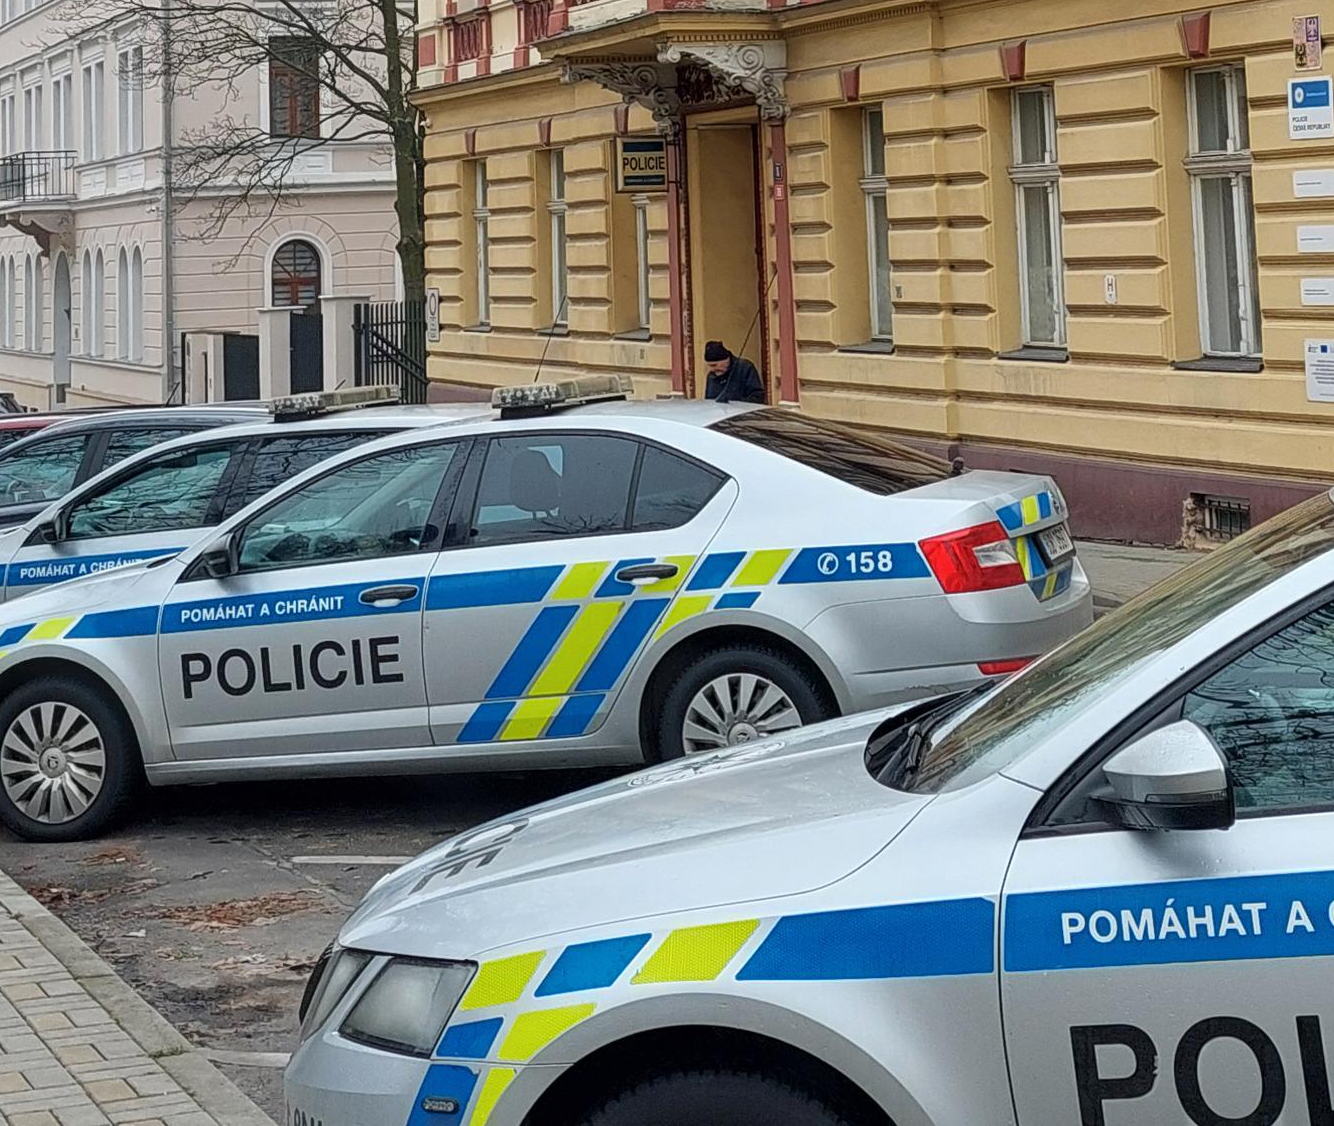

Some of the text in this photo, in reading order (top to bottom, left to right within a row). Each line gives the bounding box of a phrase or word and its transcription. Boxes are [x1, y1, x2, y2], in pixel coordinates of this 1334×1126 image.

[623, 156, 666, 171] POLICIE
[20, 563, 75, 579] POMÁHAT
[79, 562, 87, 574] A
[846, 551, 892, 573] 158
[181, 595, 344, 623] POMÁHAT A CHRÁNIT
[181, 636, 404, 699] POLICIE
[1061, 898, 1267, 945] POMÁHAT
[1286, 904, 1315, 934] A
